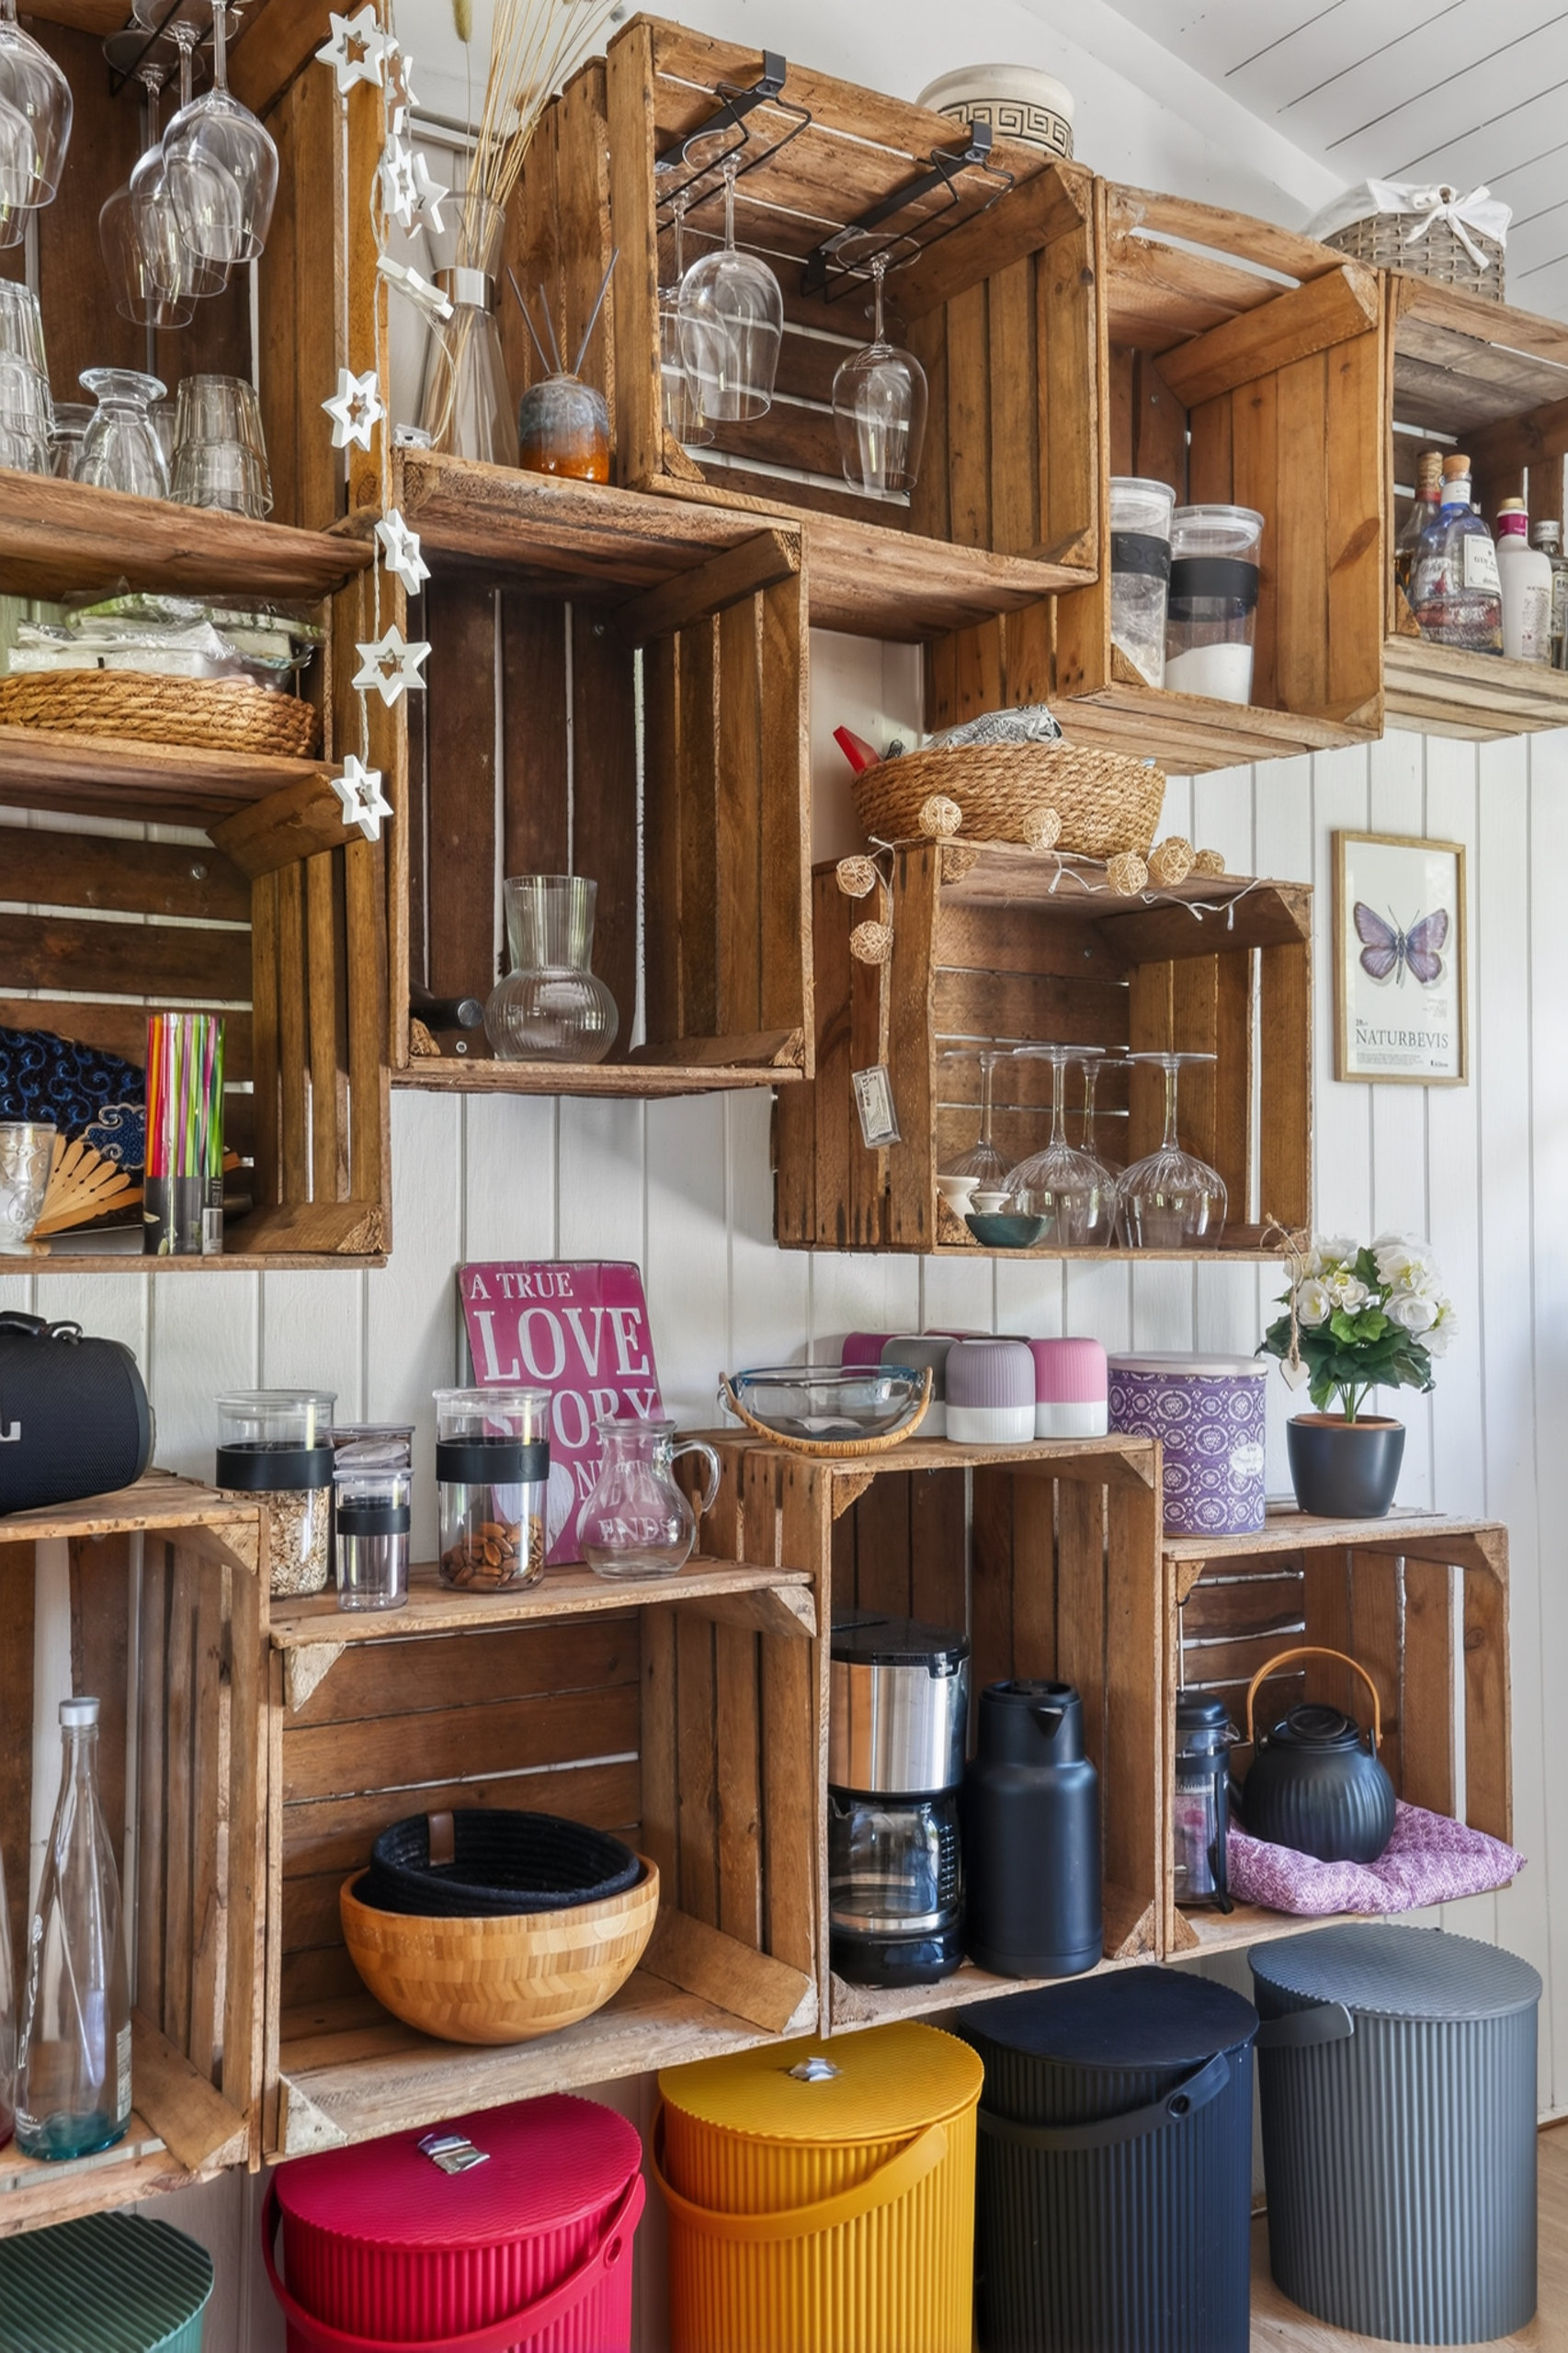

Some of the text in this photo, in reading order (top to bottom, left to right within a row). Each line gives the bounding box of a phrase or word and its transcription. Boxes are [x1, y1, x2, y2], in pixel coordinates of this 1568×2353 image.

[1356, 1029, 1449, 1049] NATURBEVIS
[470, 1272, 574, 1300] A TRUE
[473, 1307, 650, 1381] LOVE
[486, 1388, 656, 1449] SORY
